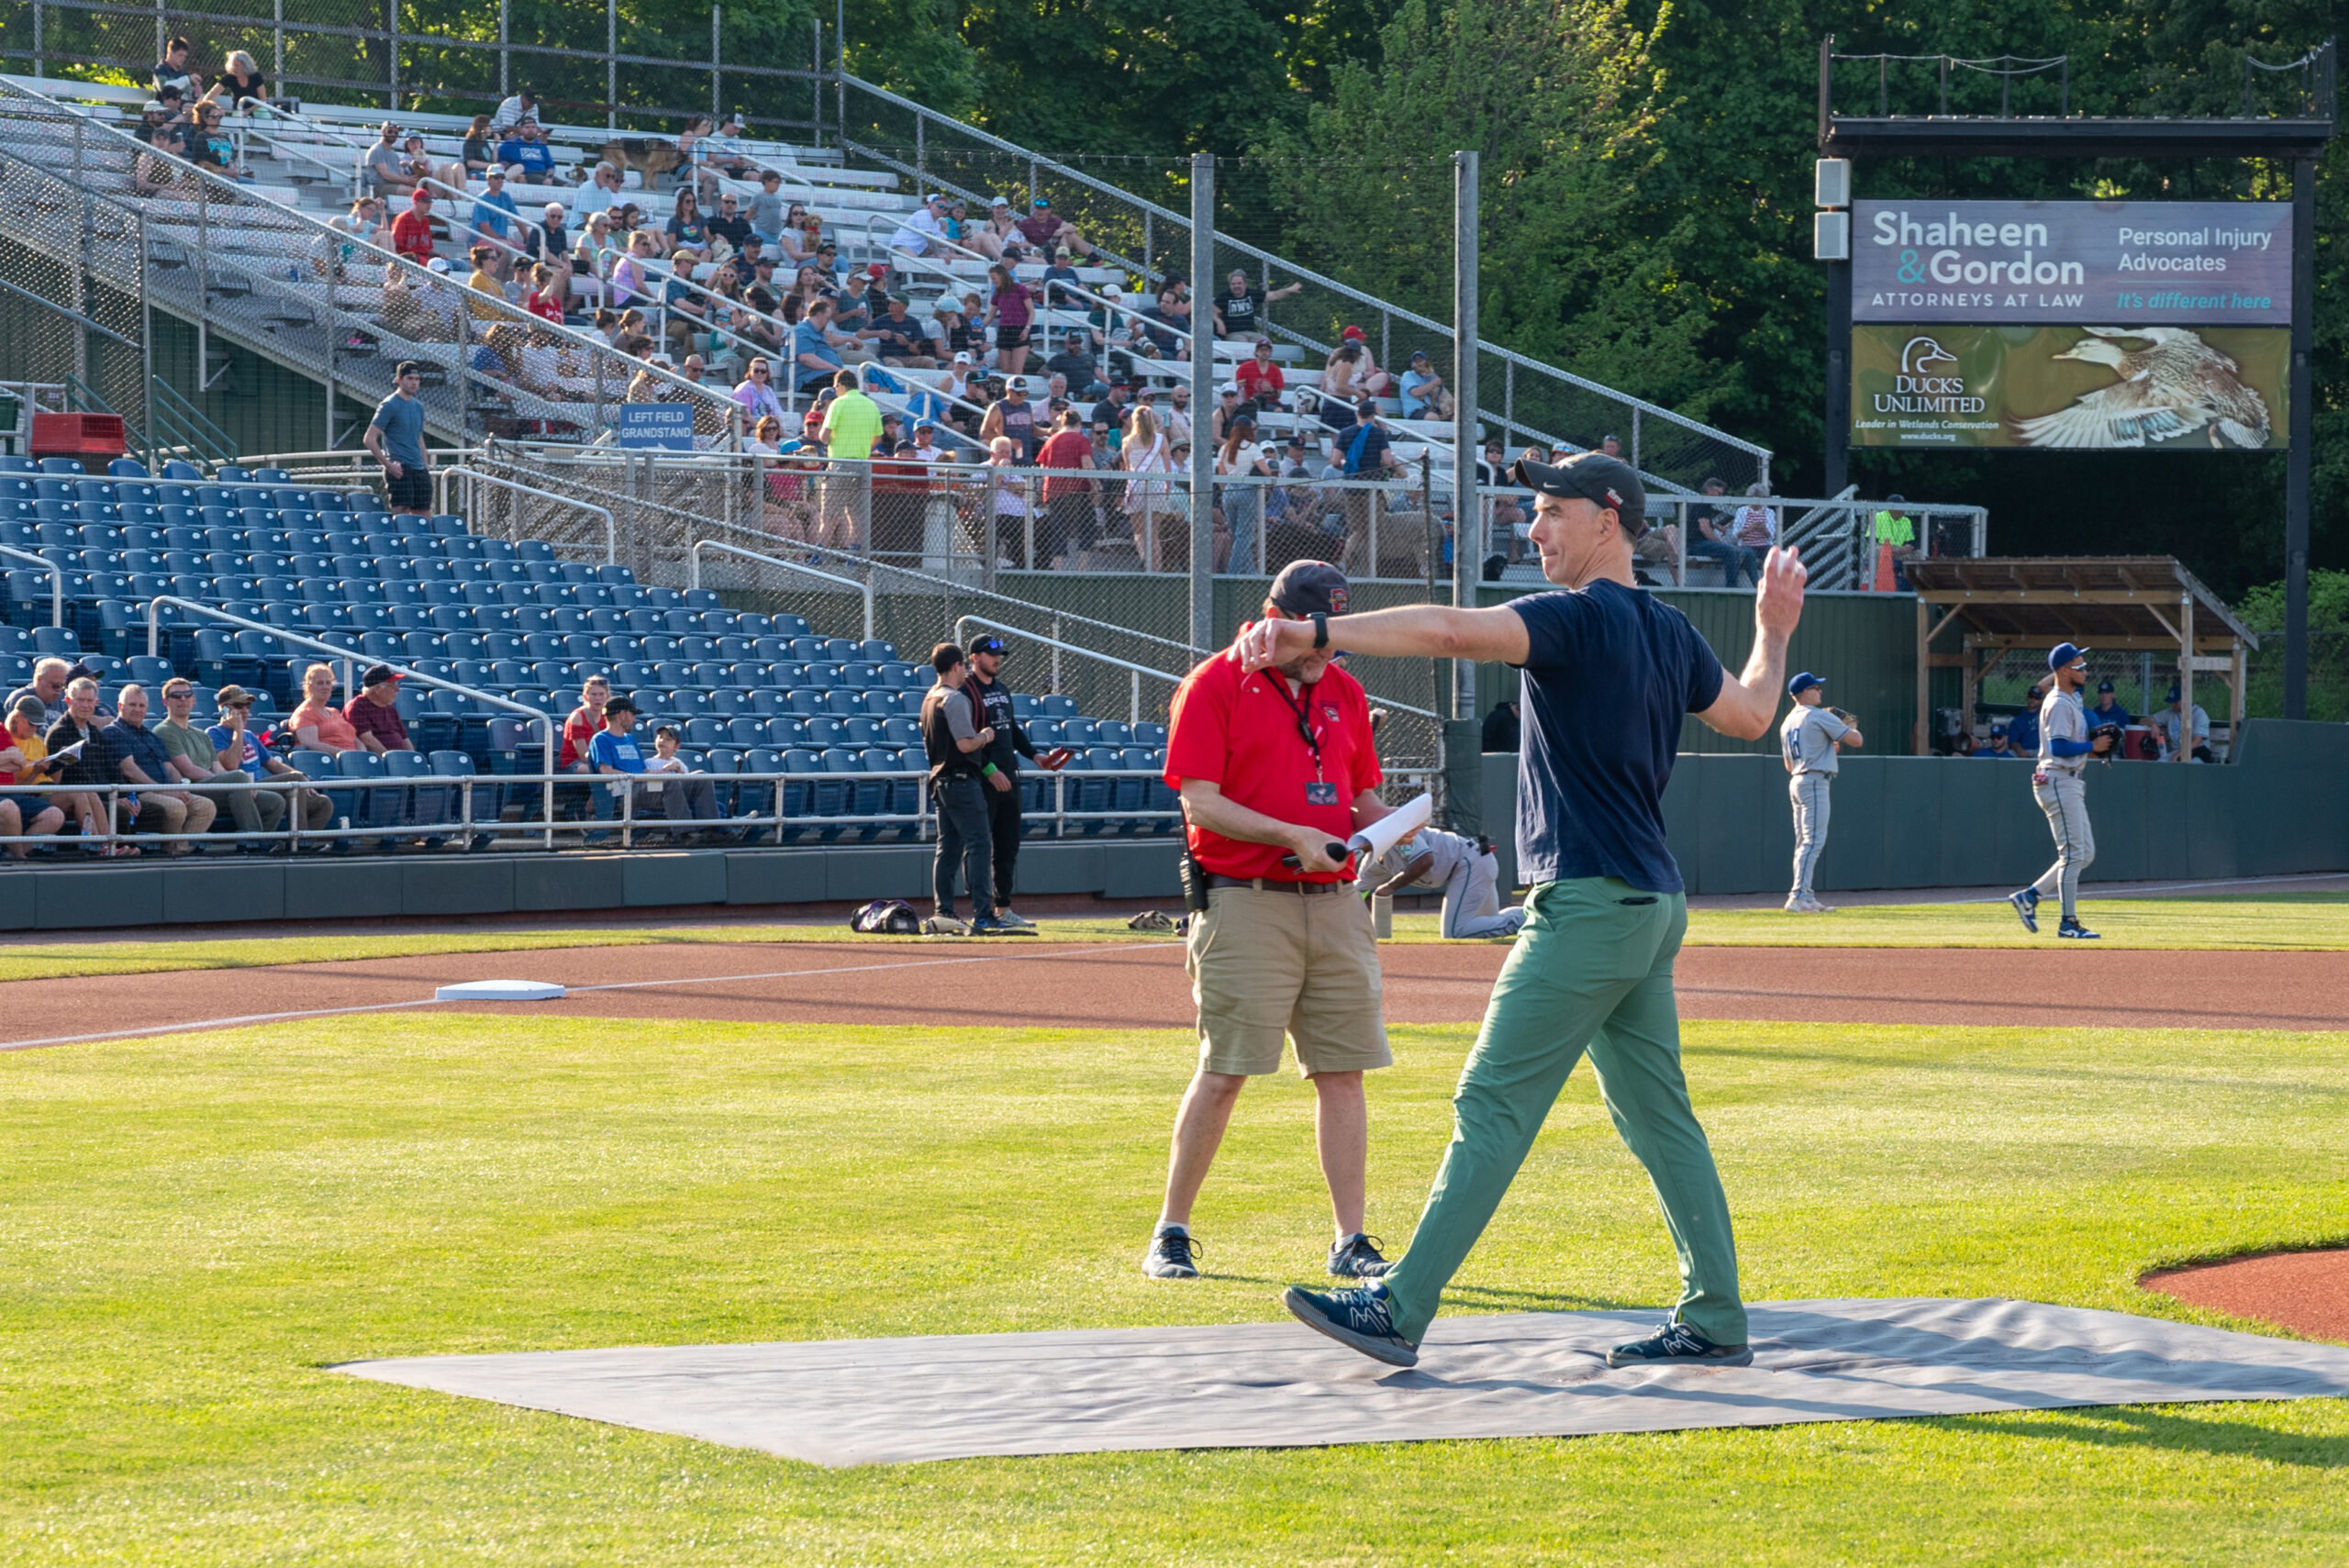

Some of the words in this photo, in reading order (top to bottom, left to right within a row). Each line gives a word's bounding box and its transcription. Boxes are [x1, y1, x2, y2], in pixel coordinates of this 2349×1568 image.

[1872, 210, 2048, 247] Shaheen
[2118, 227, 2210, 247] Personal
[2215, 228, 2273, 251] Injury
[2117, 252, 2228, 272] Advocates
[1871, 292, 1994, 307] ATTORNEYS
[2003, 293, 2029, 307] AT
[2038, 294, 2085, 308] LAW
[2117, 292, 2143, 309] It's
[2148, 292, 2227, 310] different
[2231, 292, 2272, 310] here
[1895, 374, 1965, 395] DUCKS
[1873, 394, 1986, 414] UNLIMITED
[629, 411, 653, 423] LEFT
[655, 411, 685, 423] FIELD
[1854, 419, 1886, 428] Leader
[1887, 419, 1897, 428] in
[1898, 419, 1939, 429] Wetlands
[1941, 419, 1999, 430] Conservation
[620, 427, 692, 439] GRANDSTAND
[1899, 432, 1956, 442] www.ducks.org
